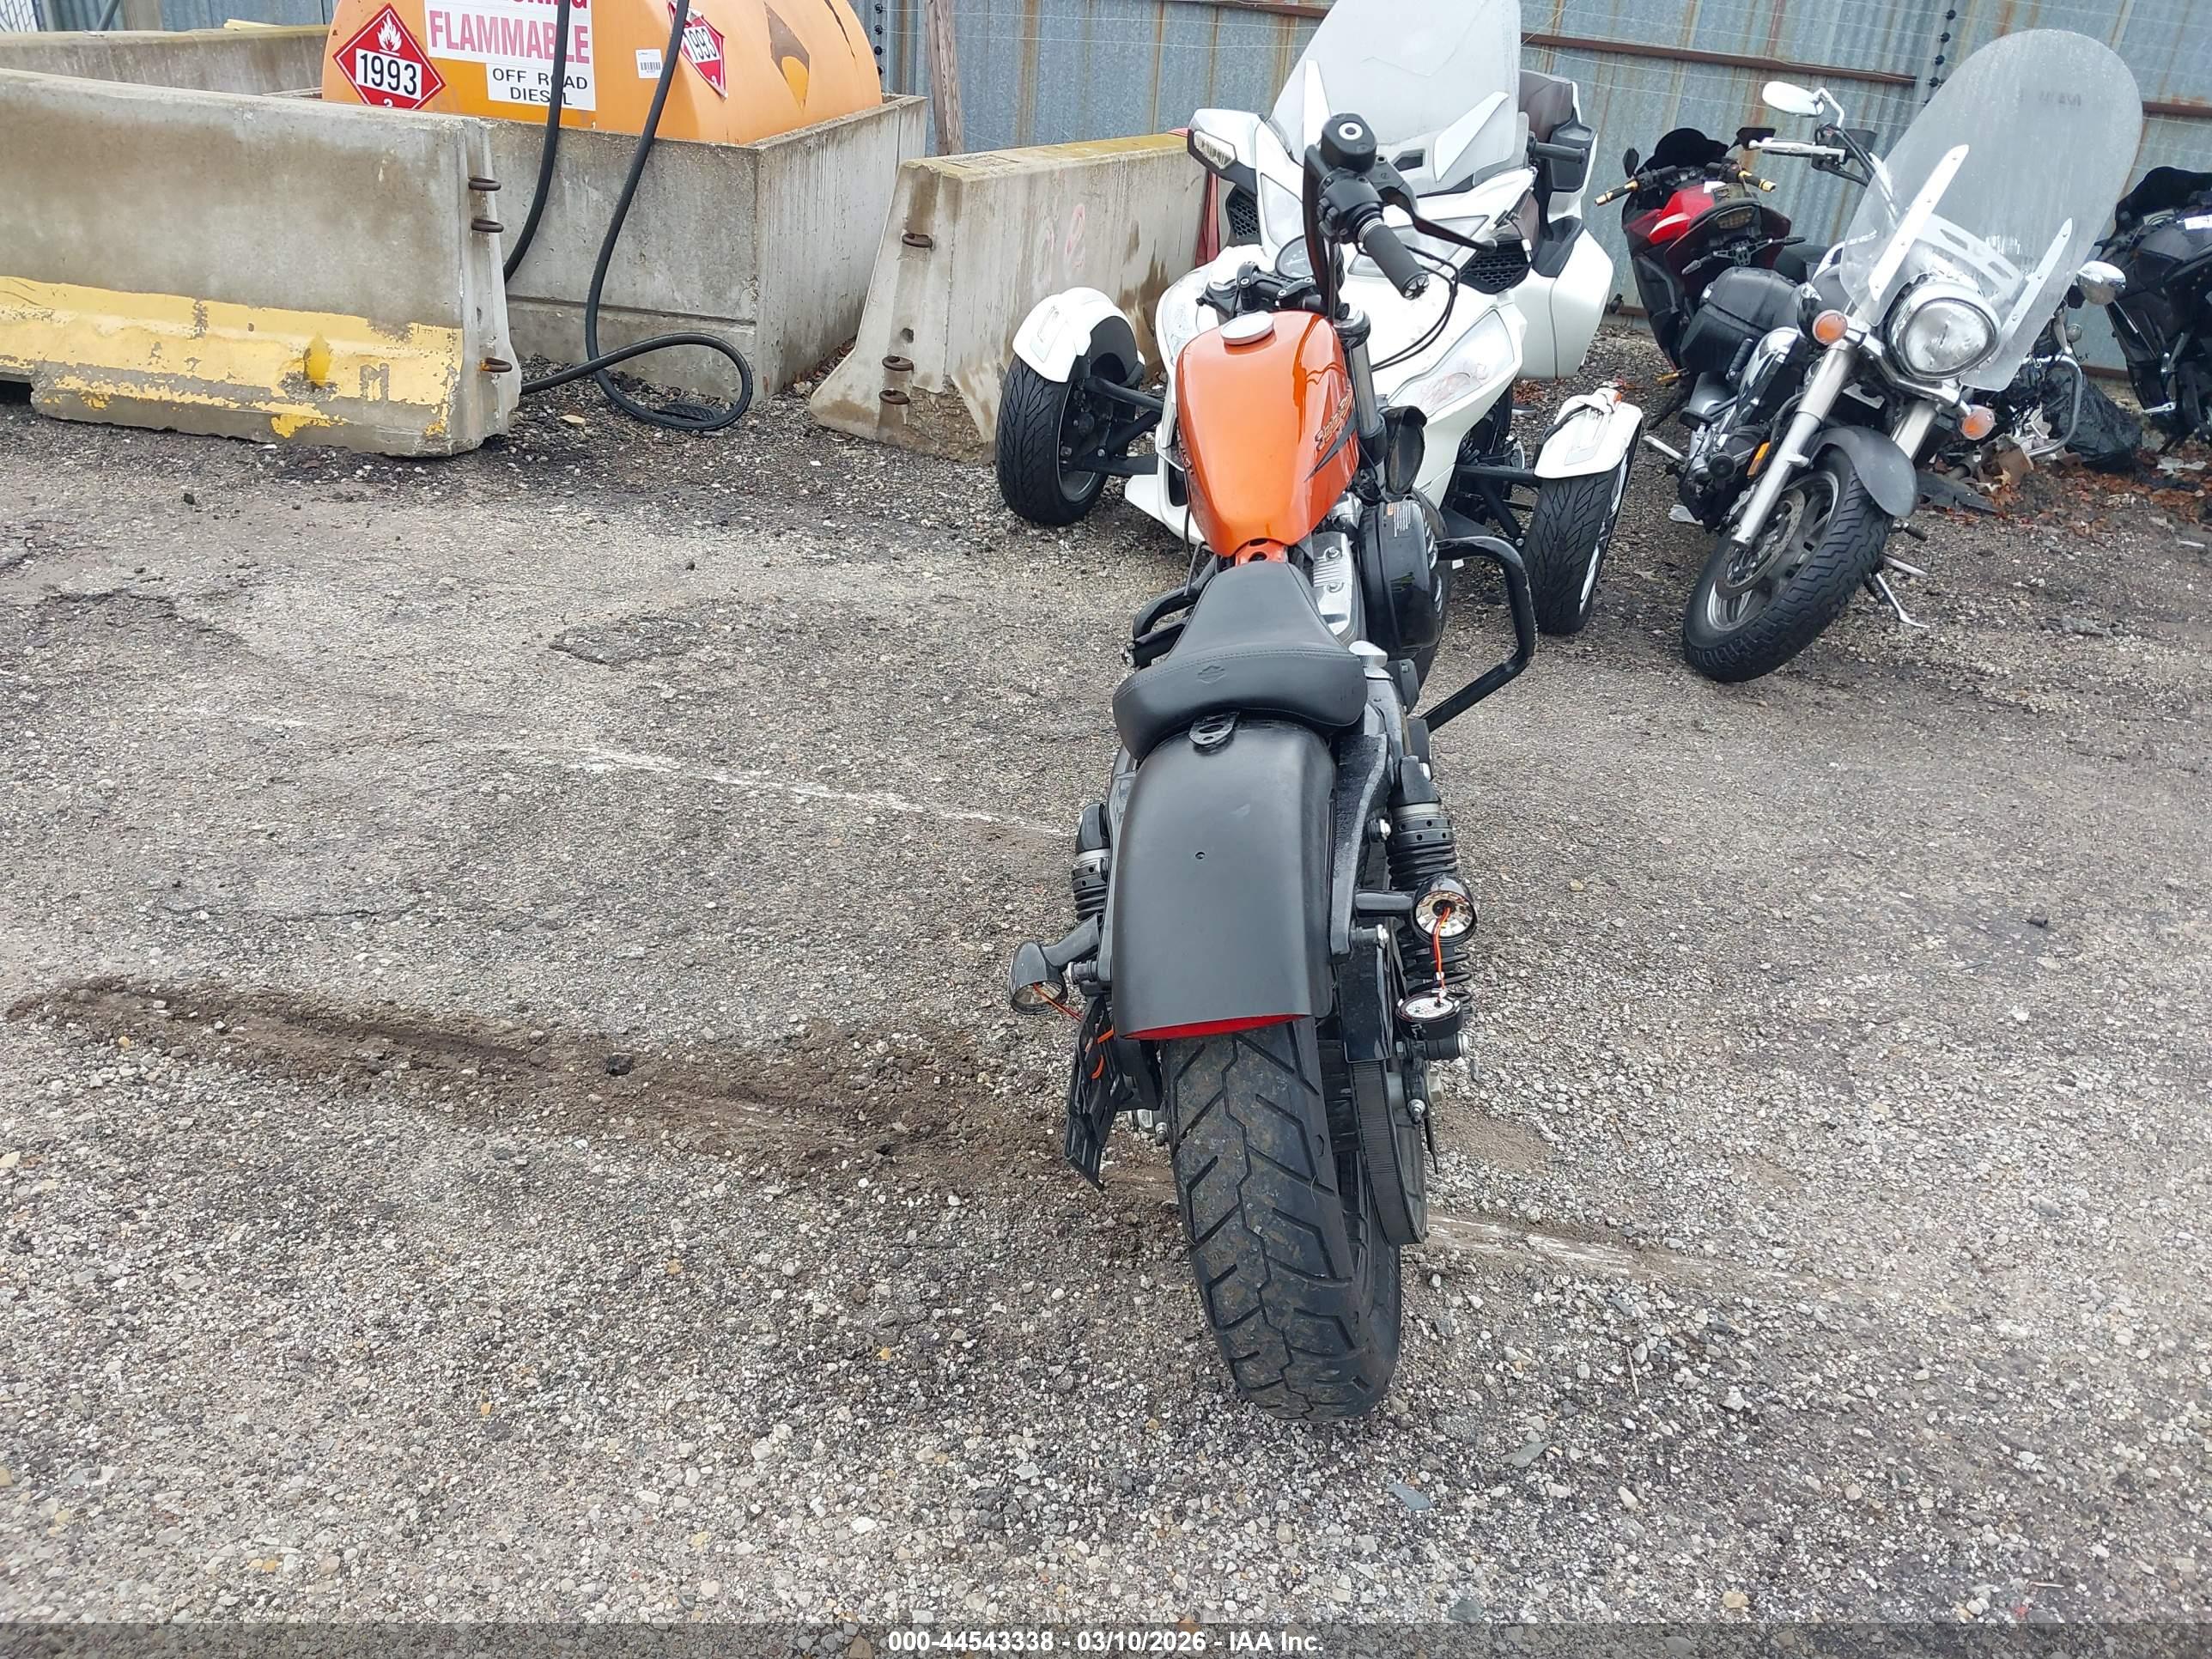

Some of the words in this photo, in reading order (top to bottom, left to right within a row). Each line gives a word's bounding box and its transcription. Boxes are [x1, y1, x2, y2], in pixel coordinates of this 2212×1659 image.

[429, 10, 590, 64] FLAMMABE
[360, 53, 417, 95] 1993
[493, 68, 527, 83] OFF
[538, 72, 588, 90] RAD
[510, 87, 573, 106] DIESL
